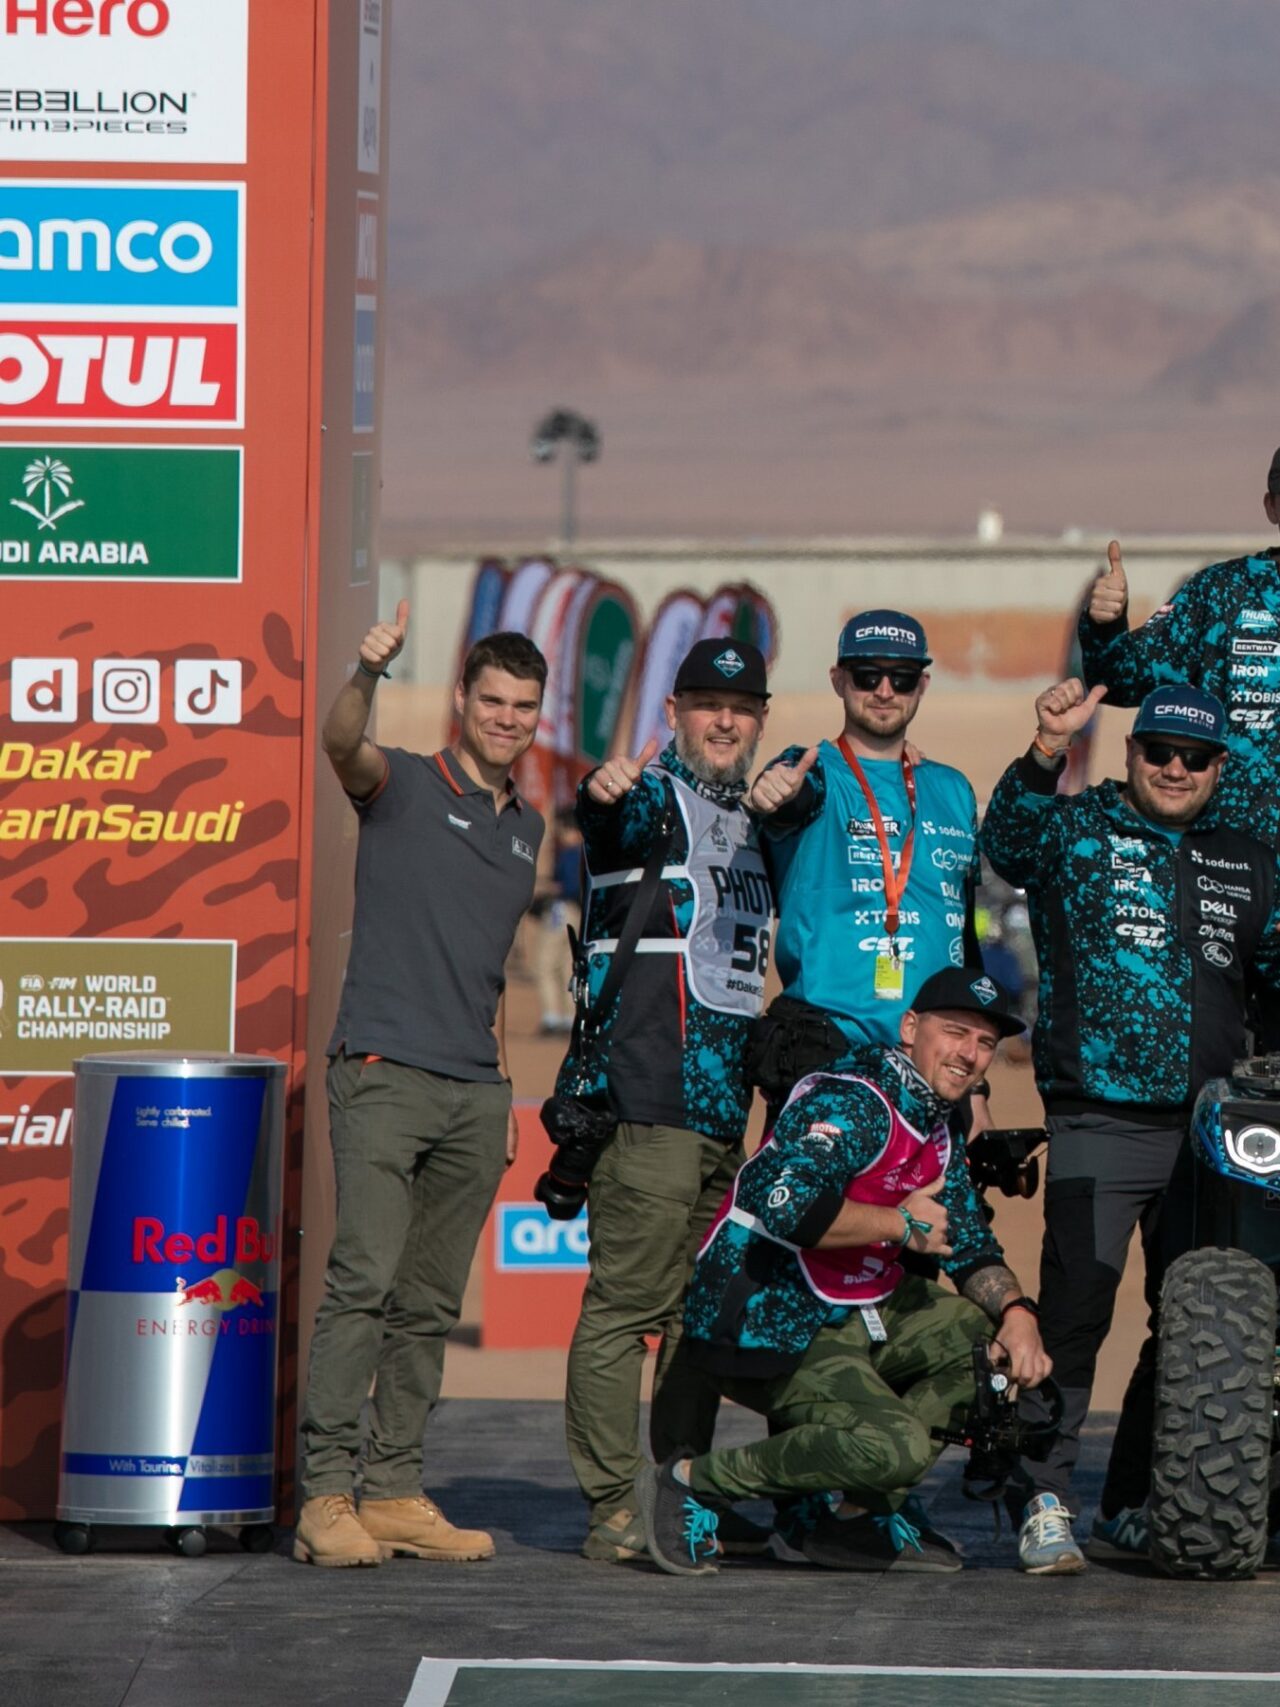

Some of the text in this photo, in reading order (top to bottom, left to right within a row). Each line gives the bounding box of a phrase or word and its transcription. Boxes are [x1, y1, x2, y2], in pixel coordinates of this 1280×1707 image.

[0, 217, 213, 273] amco
[0, 333, 221, 406] OTUL
[38, 541, 149, 565] ARABIA
[855, 625, 917, 641] CFMOTO
[1232, 664, 1269, 677] IRON
[1154, 704, 1215, 724] CFMOTO
[1229, 709, 1275, 721] CST
[0, 801, 245, 843] arInSaudi
[1200, 899, 1238, 918] DELL
[1115, 923, 1166, 938] CST
[731, 922, 770, 978] 58
[858, 936, 914, 951] CST
[85, 975, 157, 993] WORLD
[18, 996, 166, 1019] RALLY-RAID
[17, 1020, 171, 1040] CHAMPIONSHIP
[0, 1104, 73, 1146] cial
[136, 1117, 159, 1127] Serve
[133, 1215, 227, 1264] Red
[137, 1318, 231, 1336] ENERGY
[109, 1459, 136, 1472] With
